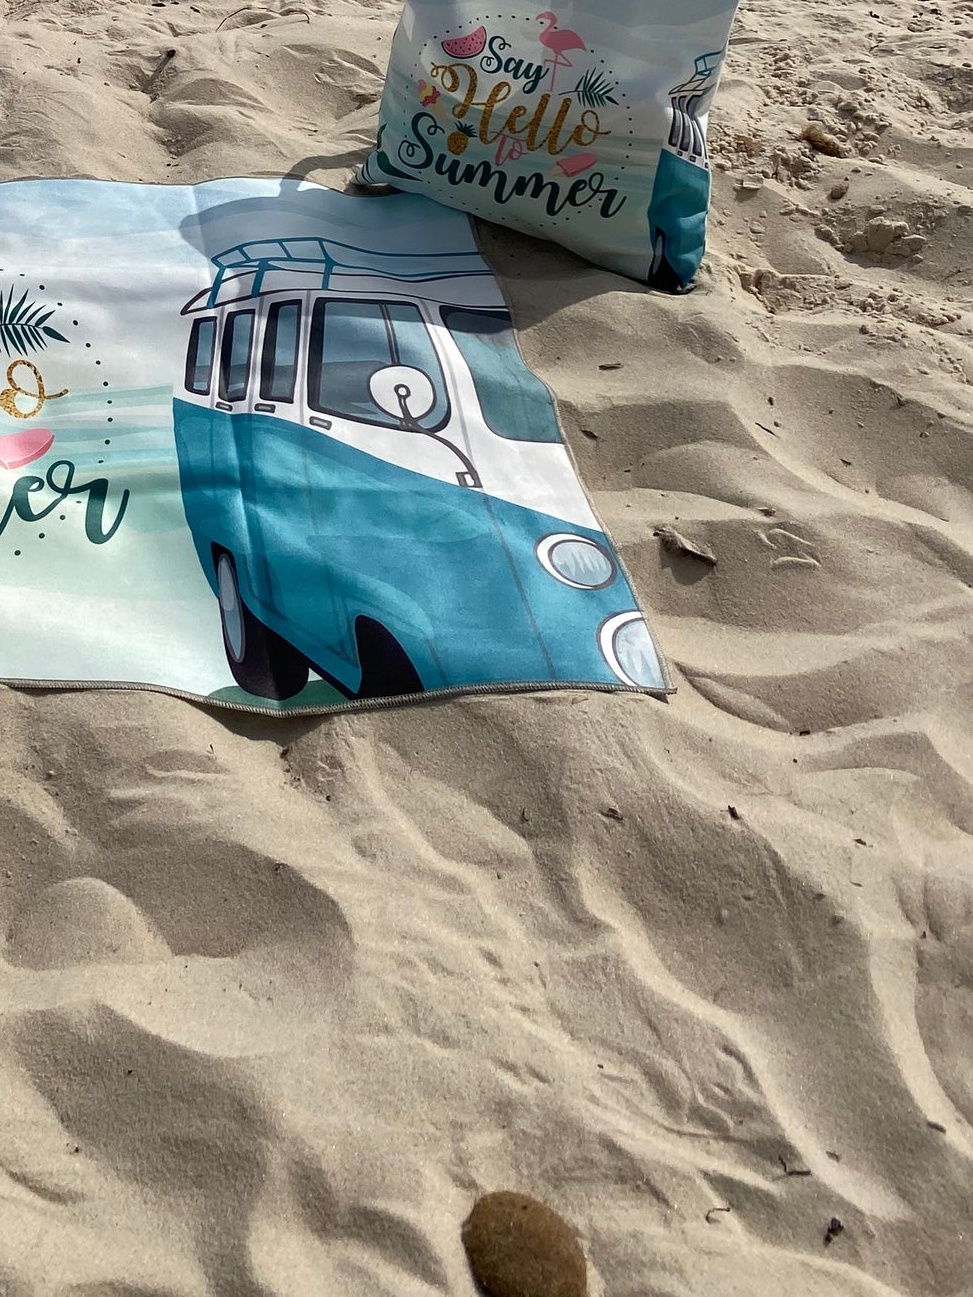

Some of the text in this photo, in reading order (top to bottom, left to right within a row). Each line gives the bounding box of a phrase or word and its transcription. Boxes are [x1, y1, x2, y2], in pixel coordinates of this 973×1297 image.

[430, 62, 611, 155] Hello
[480, 35, 549, 94] Say
[398, 112, 626, 218] Summer
